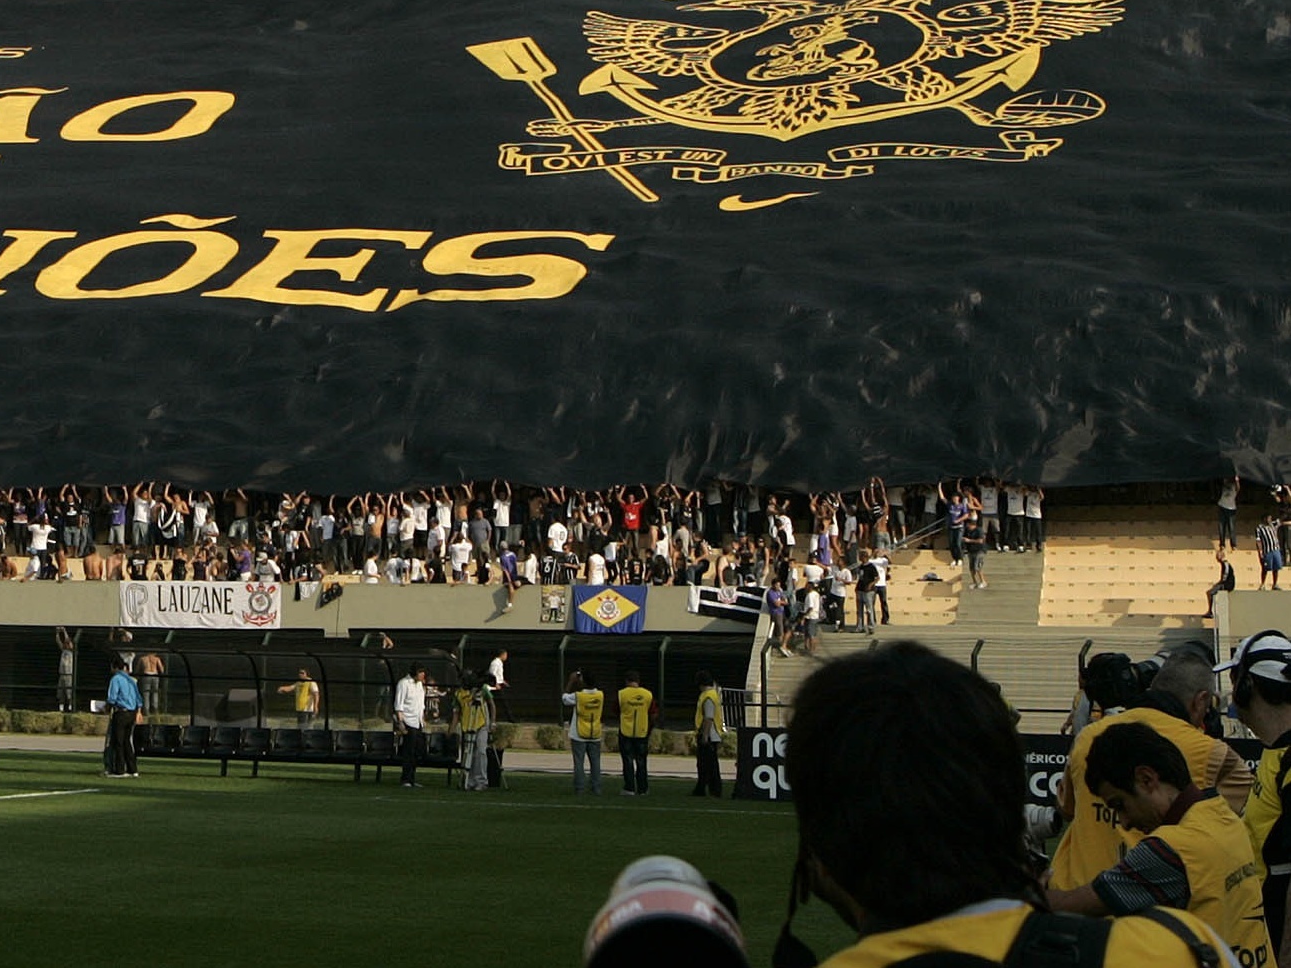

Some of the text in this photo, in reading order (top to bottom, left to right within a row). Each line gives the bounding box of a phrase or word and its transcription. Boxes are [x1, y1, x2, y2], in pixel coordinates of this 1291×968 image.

[619, 151, 673, 163] EST
[681, 151, 716, 161] UN
[848, 147, 879, 158] DI
[731, 165, 817, 177] BANDO
[157, 585, 234, 615] LAUZANE
